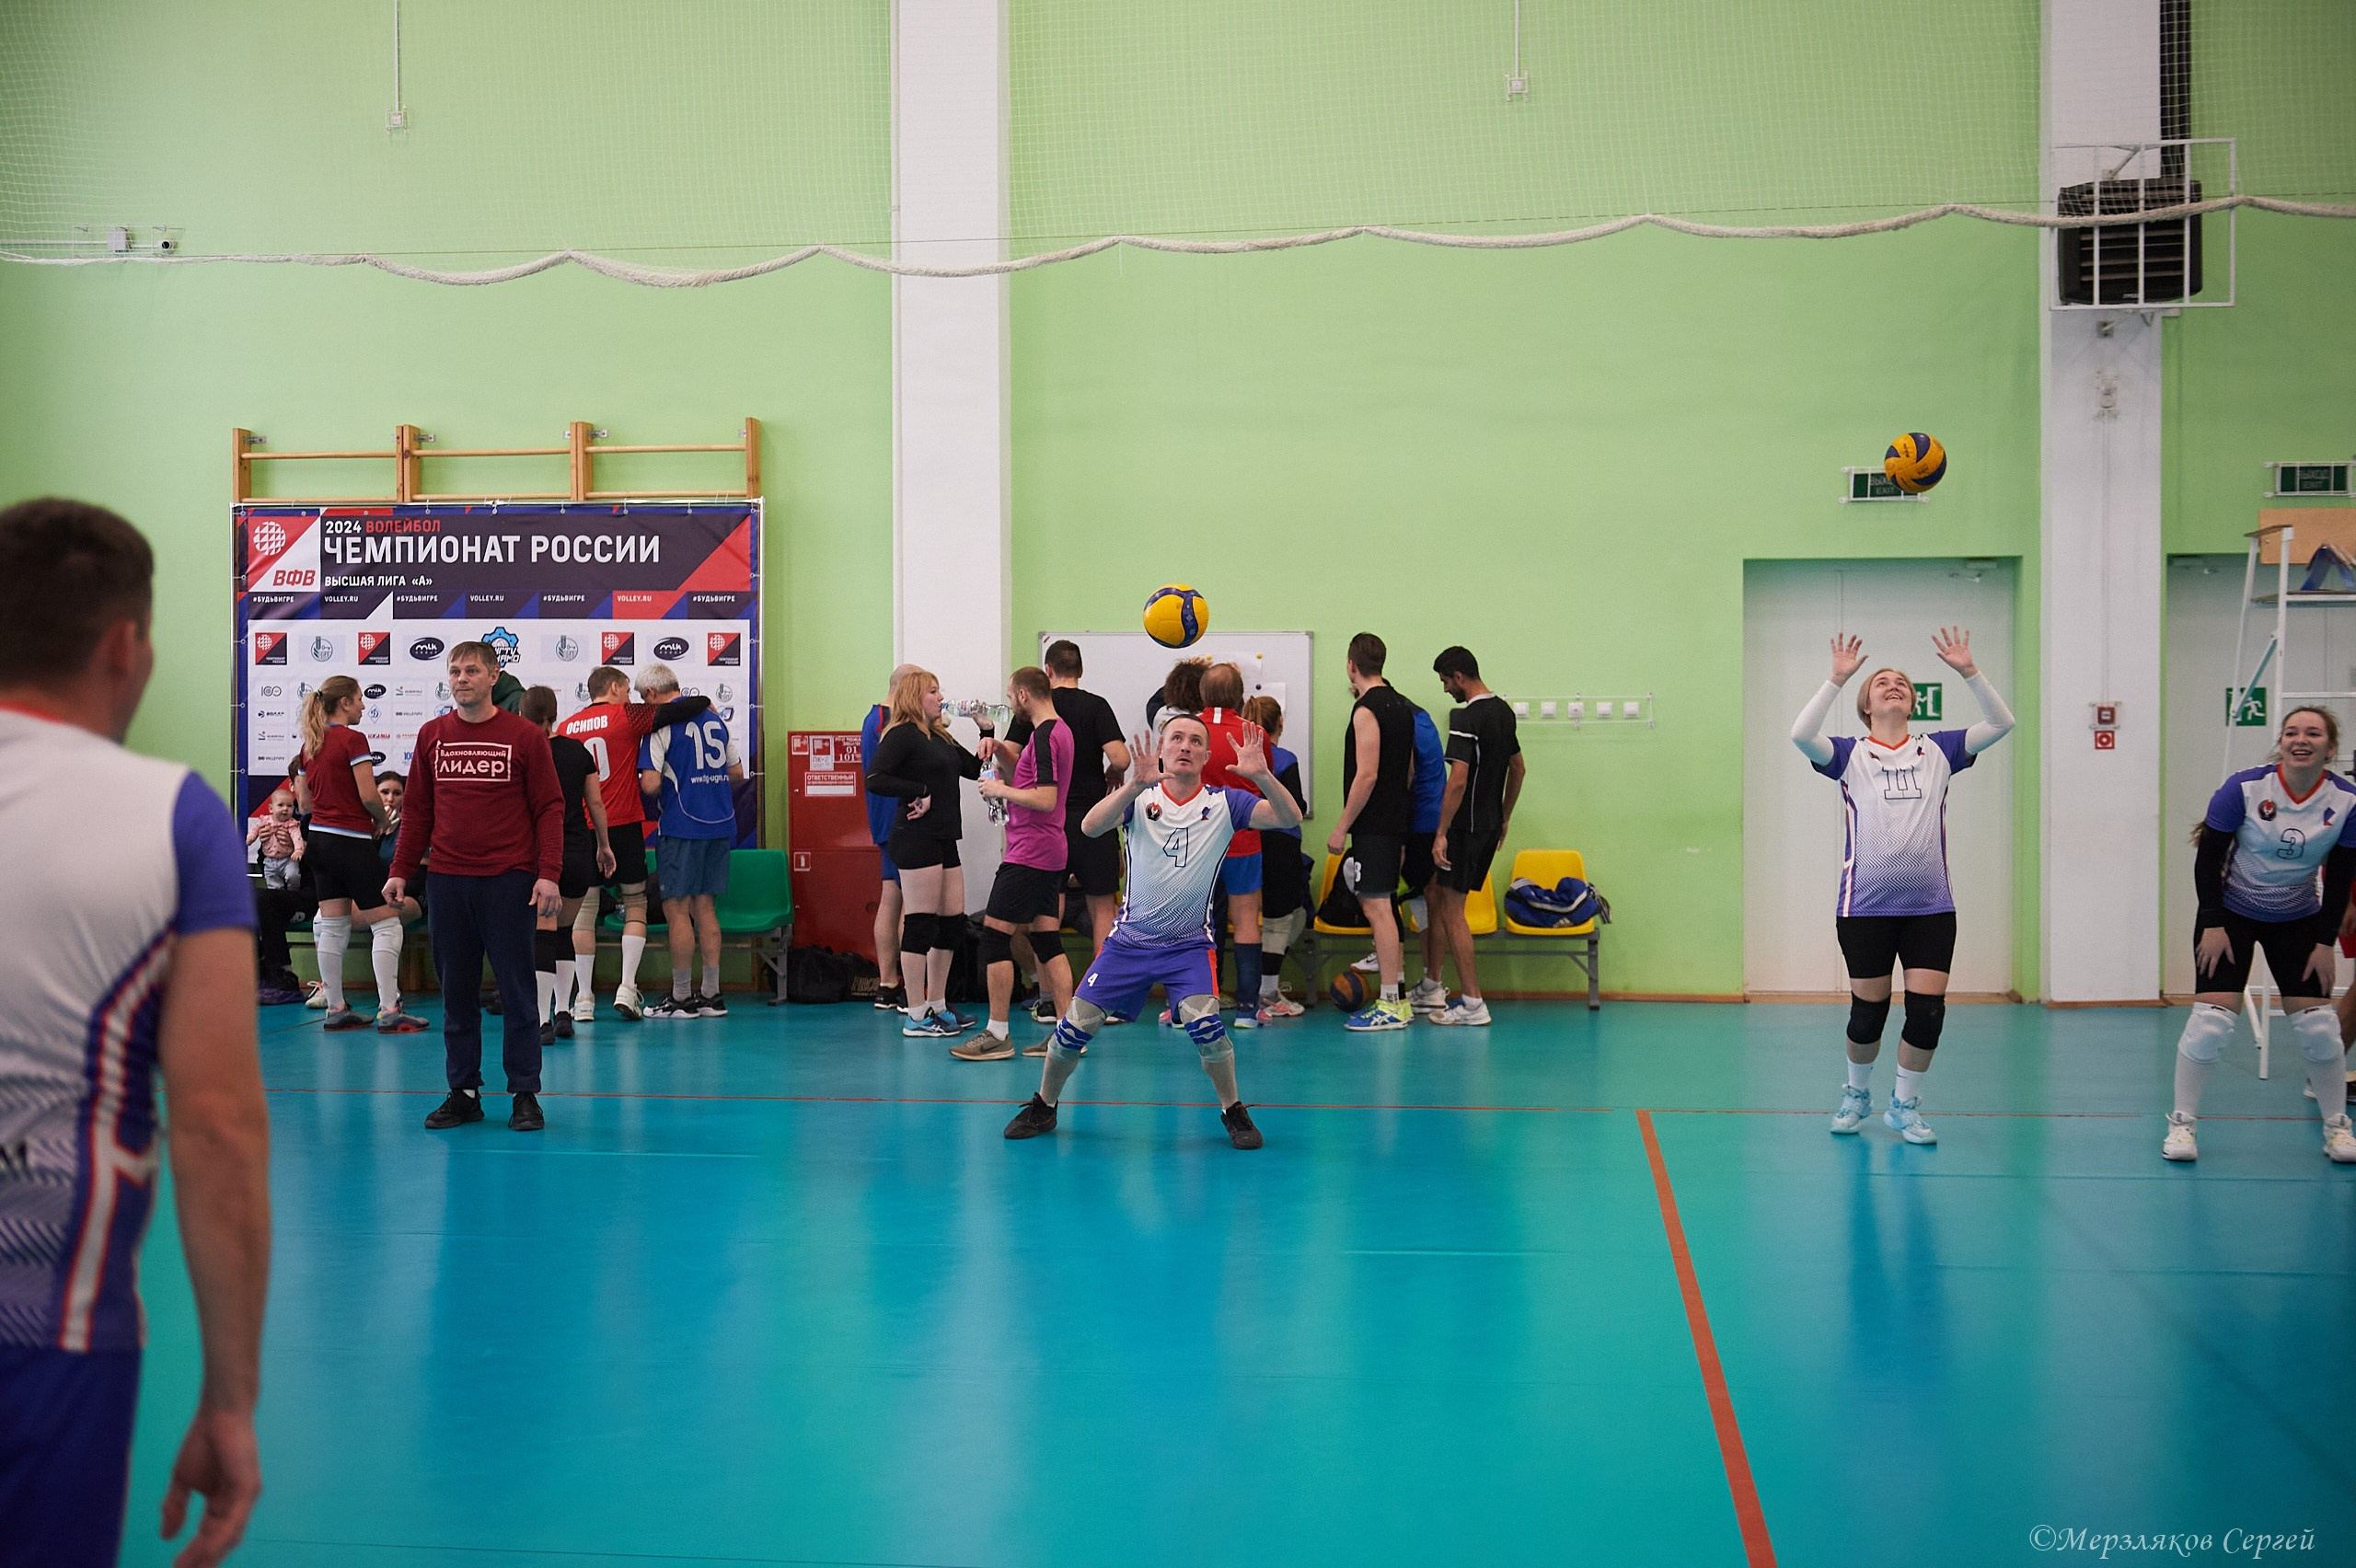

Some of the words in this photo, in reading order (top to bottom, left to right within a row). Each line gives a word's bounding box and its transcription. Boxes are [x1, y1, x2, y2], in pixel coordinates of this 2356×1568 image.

[325, 520, 362, 534] 2024
[365, 517, 441, 533] ВОЛЕЙБОЛ
[324, 535, 521, 563] ЧЕМПИОНАТ
[531, 535, 660, 563] РОССИИ
[272, 569, 316, 586] ВФВ
[324, 575, 375, 587] ВЫСШАЯ
[377, 575, 406, 586] ЛИГА
[411, 575, 433, 587] «А»
[252, 595, 294, 604] #БУДЬВИГРЕ
[397, 594, 438, 603] #БУДЬВИГРЕ
[543, 594, 585, 603] #БУДЬВИГРЕ
[692, 594, 735, 603] #БУДЬВИГРЕ
[566, 715, 608, 735] ОСИПОВ
[685, 721, 727, 770] 15
[846, 745, 857, 754] 01
[440, 749, 507, 758] Вдохновляющий
[839, 753, 855, 762] 101
[439, 759, 505, 778] лидер
[1162, 827, 1189, 868] 4
[2276, 828, 2306, 859] 3
[1087, 973, 1098, 987] 4
